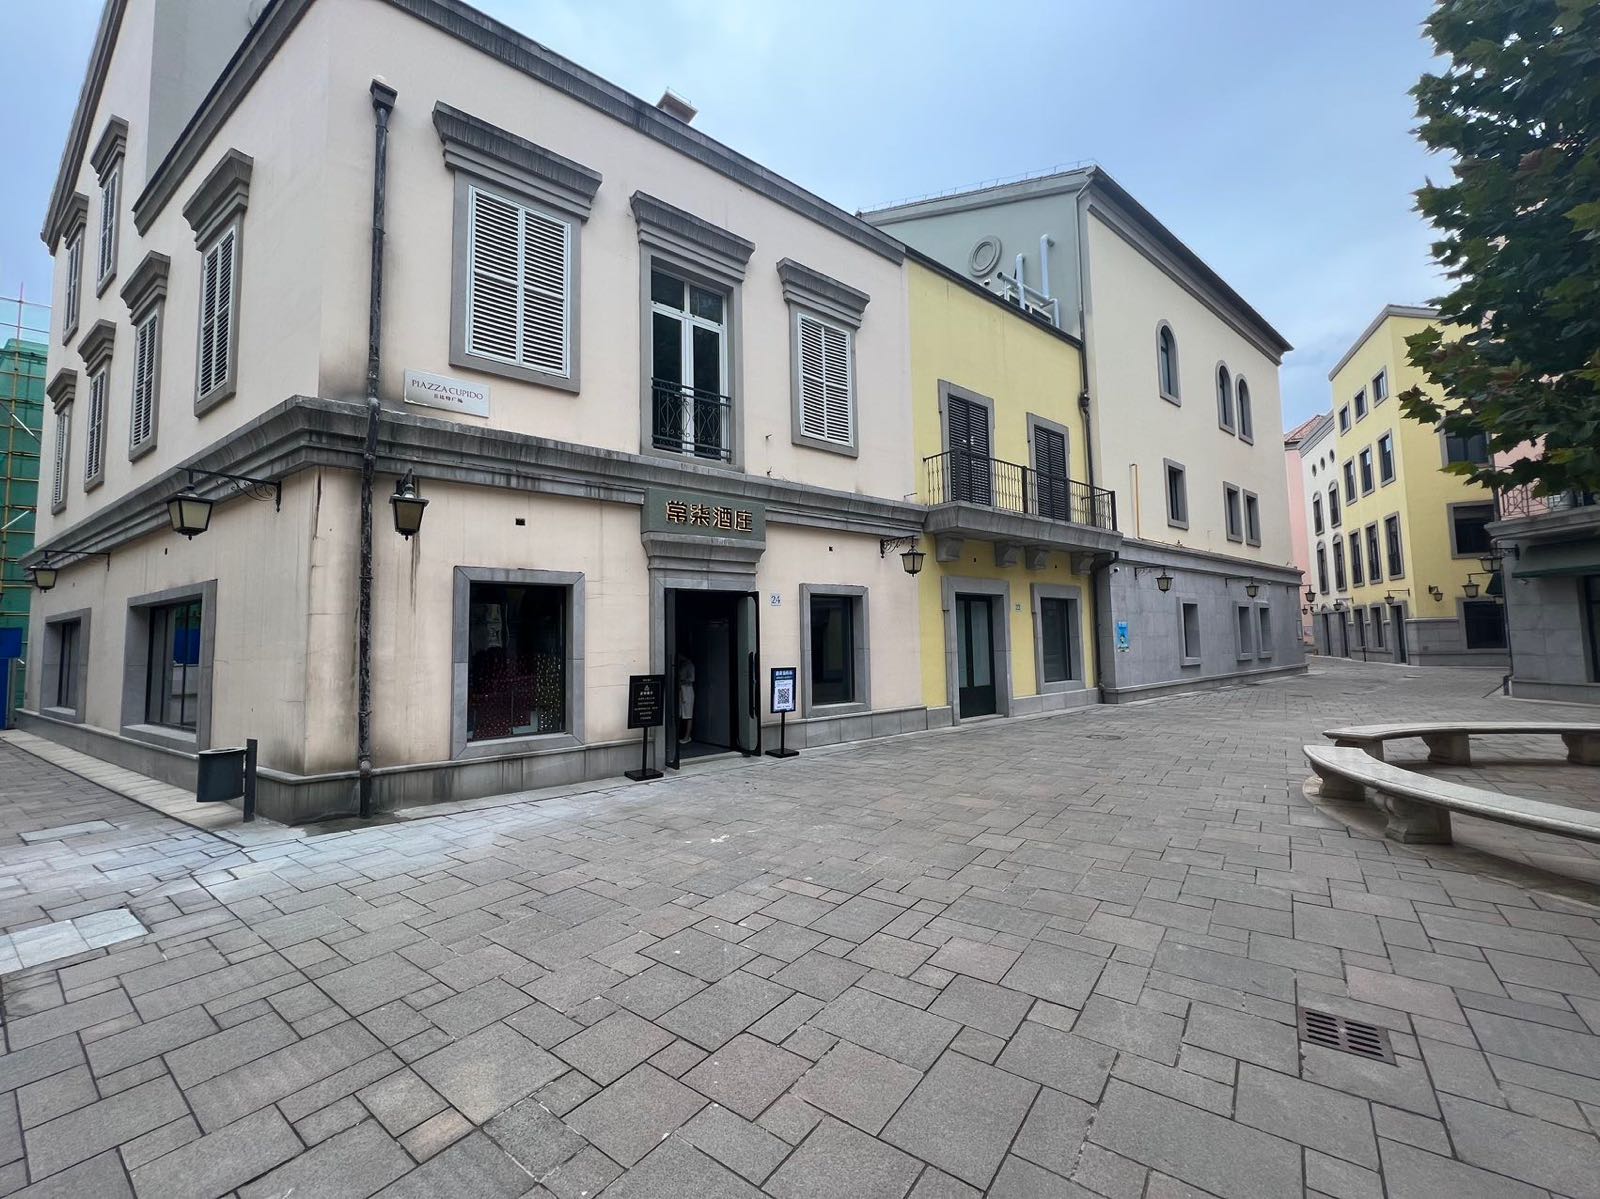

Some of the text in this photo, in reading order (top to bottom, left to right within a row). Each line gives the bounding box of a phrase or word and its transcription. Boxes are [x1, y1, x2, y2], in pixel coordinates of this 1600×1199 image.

[411, 379, 484, 400] PIAZZA CUPIDO
[665, 500, 752, 532] 常柒酒庄
[770, 595, 781, 604] 24
